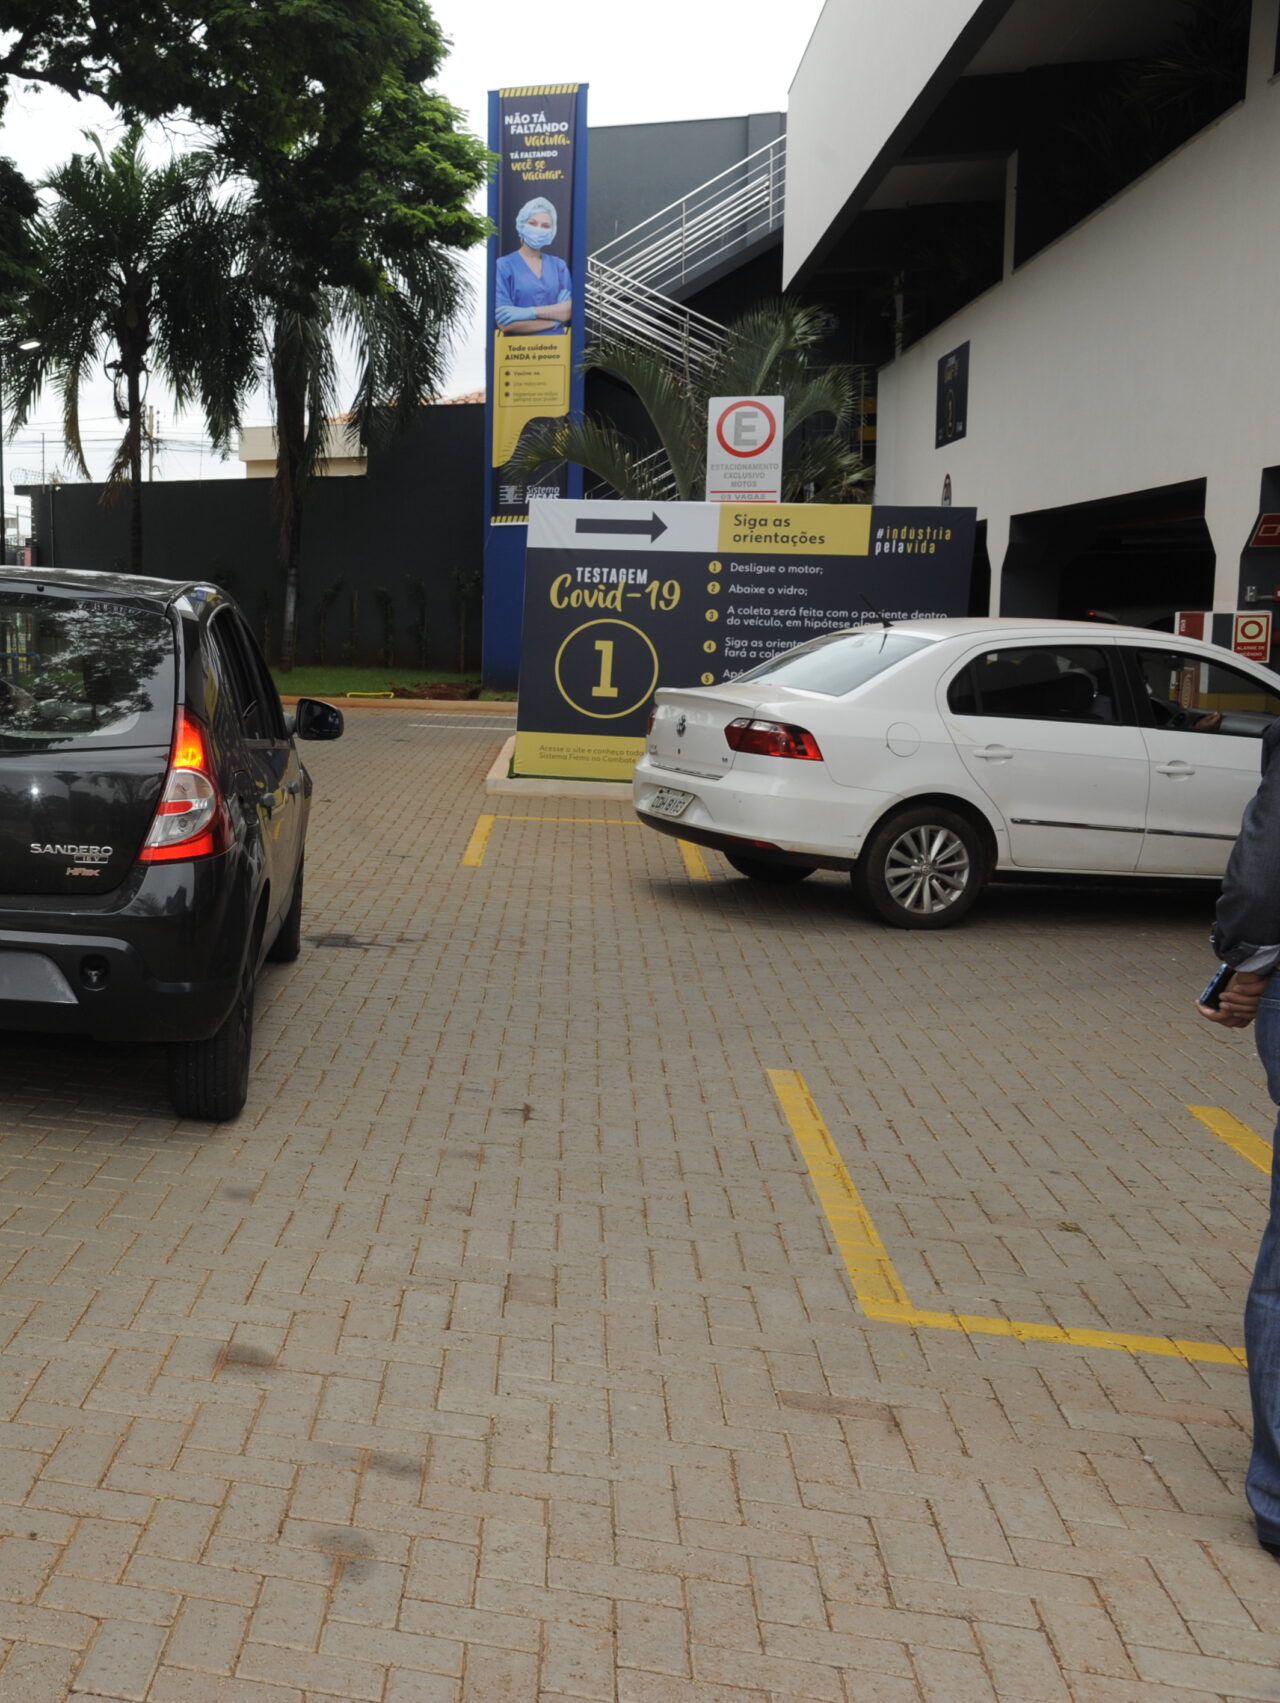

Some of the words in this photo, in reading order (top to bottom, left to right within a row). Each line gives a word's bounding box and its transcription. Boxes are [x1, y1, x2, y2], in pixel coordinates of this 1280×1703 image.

[504, 112, 530, 125] NÃO
[531, 111, 546, 123] TÁ
[510, 122, 569, 135] FALTANDO
[509, 150, 520, 159] TÁ
[520, 150, 558, 159] FALTANDO
[511, 159, 532, 171] você
[535, 160, 546, 170] se
[733, 411, 758, 446] E
[710, 463, 779, 471] ESTACIONAMENTO
[723, 471, 766, 479] EXCLUSIVO
[526, 485, 560, 494] Sistema
[730, 480, 757, 488] MOTOS
[733, 514, 768, 530] Siga
[773, 518, 791, 528] as
[732, 530, 826, 547] orientações
[875, 540, 936, 556] pelavida
[730, 562, 776, 575] Desligue
[778, 565, 786, 573] o
[787, 565, 824, 575] motor;
[576, 567, 648, 584] TESTAGEM
[549, 573, 681, 612] Covid-19
[728, 584, 766, 594] Abaixe
[767, 586, 775, 595] o
[777, 585, 808, 596] vidro;
[727, 605, 735, 615] A
[737, 606, 771, 616] coleta
[773, 607, 797, 617] será
[799, 607, 824, 617] feita
[826, 609, 849, 619] com
[851, 610, 859, 619] o
[910, 610, 948, 619] dentro
[726, 616, 741, 626] do
[743, 617, 783, 628] veículo,
[785, 620, 802, 628] em
[804, 618, 850, 630] hipótese
[724, 637, 748, 649] Siga
[750, 639, 764, 648] as
[724, 648, 747, 658] fará
[749, 650, 757, 658] a
[592, 640, 618, 698] 1
[723, 668, 744, 680] Apó
[539, 744, 564, 752] Acesse
[573, 744, 586, 754] site
[539, 751, 567, 760] Sistema
[602, 755, 636, 764] Combate
[30, 843, 113, 856] SANDERO
